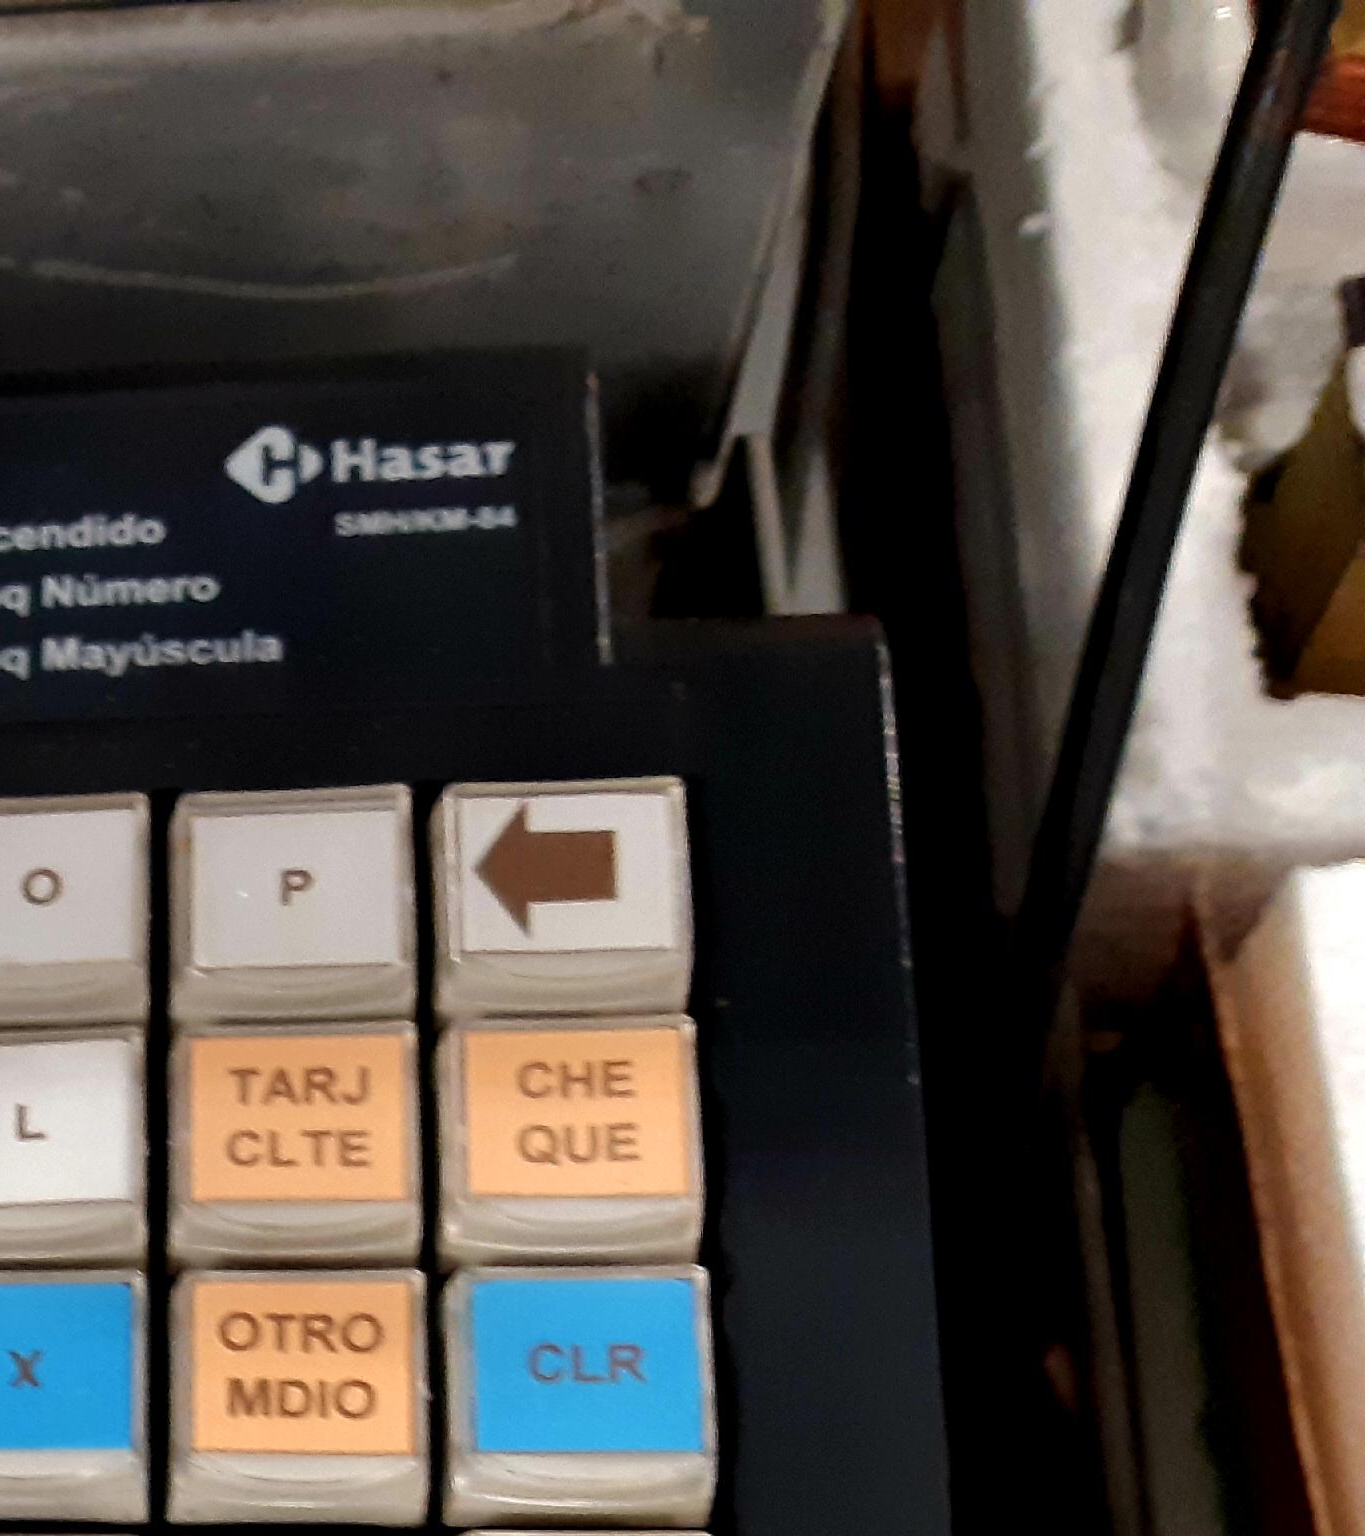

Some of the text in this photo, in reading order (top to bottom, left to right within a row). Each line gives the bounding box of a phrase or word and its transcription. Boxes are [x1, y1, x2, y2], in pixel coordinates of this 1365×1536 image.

[331, 438, 514, 483] Hasar
[41, 574, 220, 608] Número
[41, 630, 283, 676] Mayúscula
[280, 869, 313, 905] P
[227, 1066, 369, 1105] TARJ
[516, 1059, 634, 1099] CHE
[15, 1104, 46, 1141] L
[225, 1129, 370, 1168] CLTE
[516, 1122, 640, 1165] QUE
[218, 1311, 385, 1354] OTRO
[9, 1351, 41, 1388] X
[526, 1341, 645, 1384] CLR
[227, 1378, 376, 1420] MDIO
